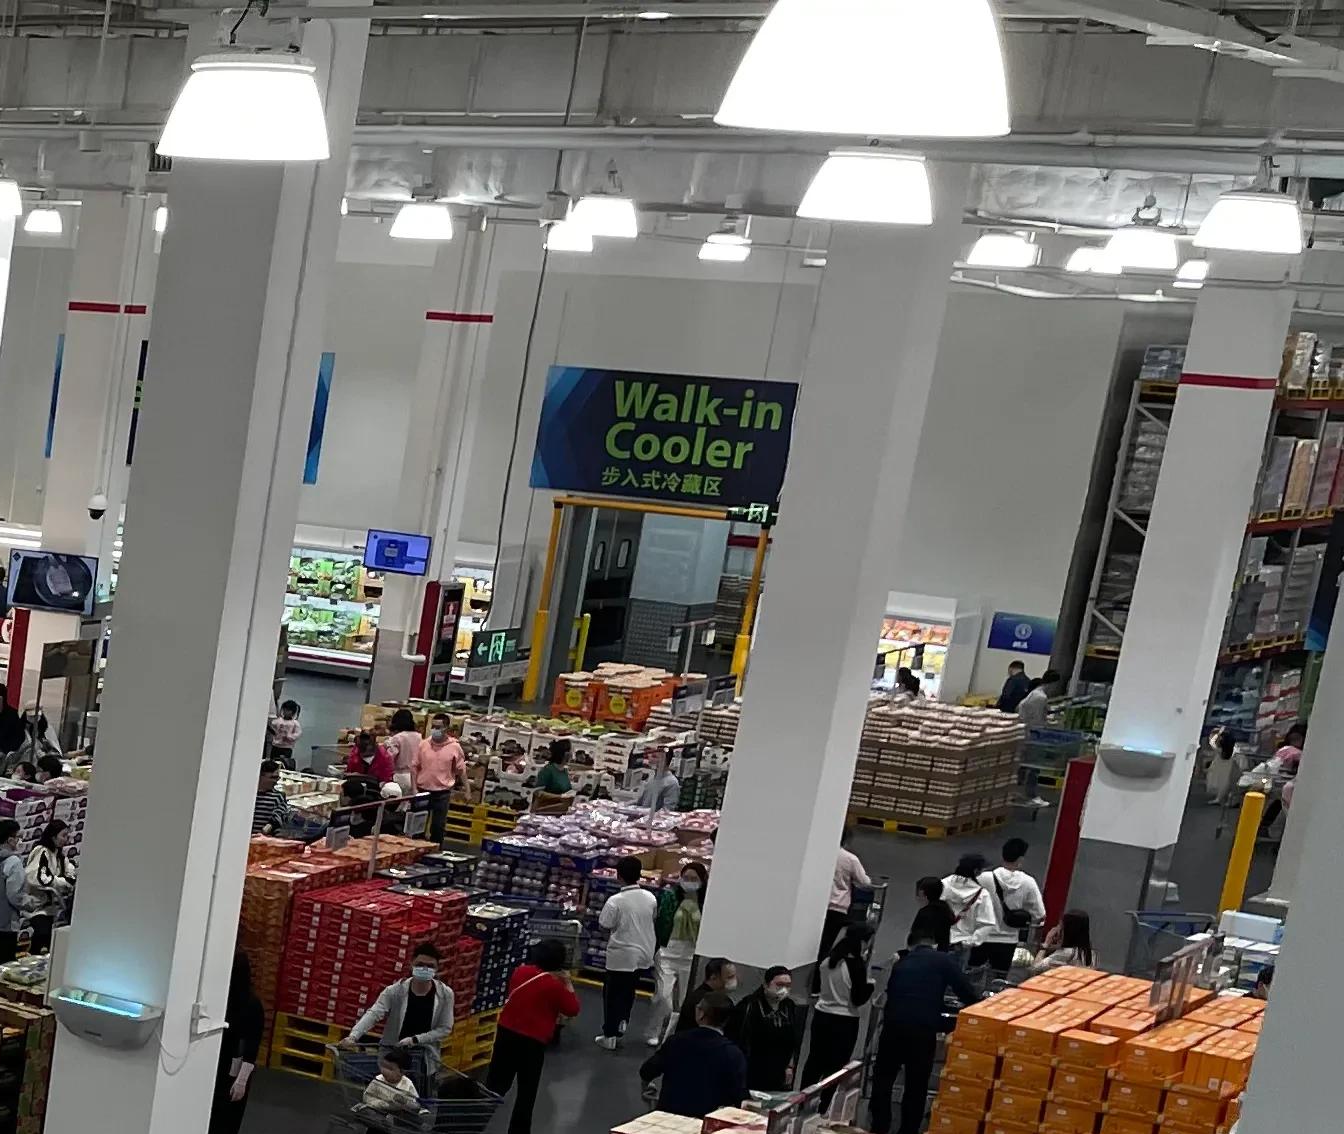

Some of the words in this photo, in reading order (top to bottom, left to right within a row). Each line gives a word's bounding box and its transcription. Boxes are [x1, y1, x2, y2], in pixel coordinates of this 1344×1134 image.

[614, 380, 784, 431] Walk-in
[604, 420, 754, 469] Cooler
[600, 466, 724, 497] 步入式冷藏区
